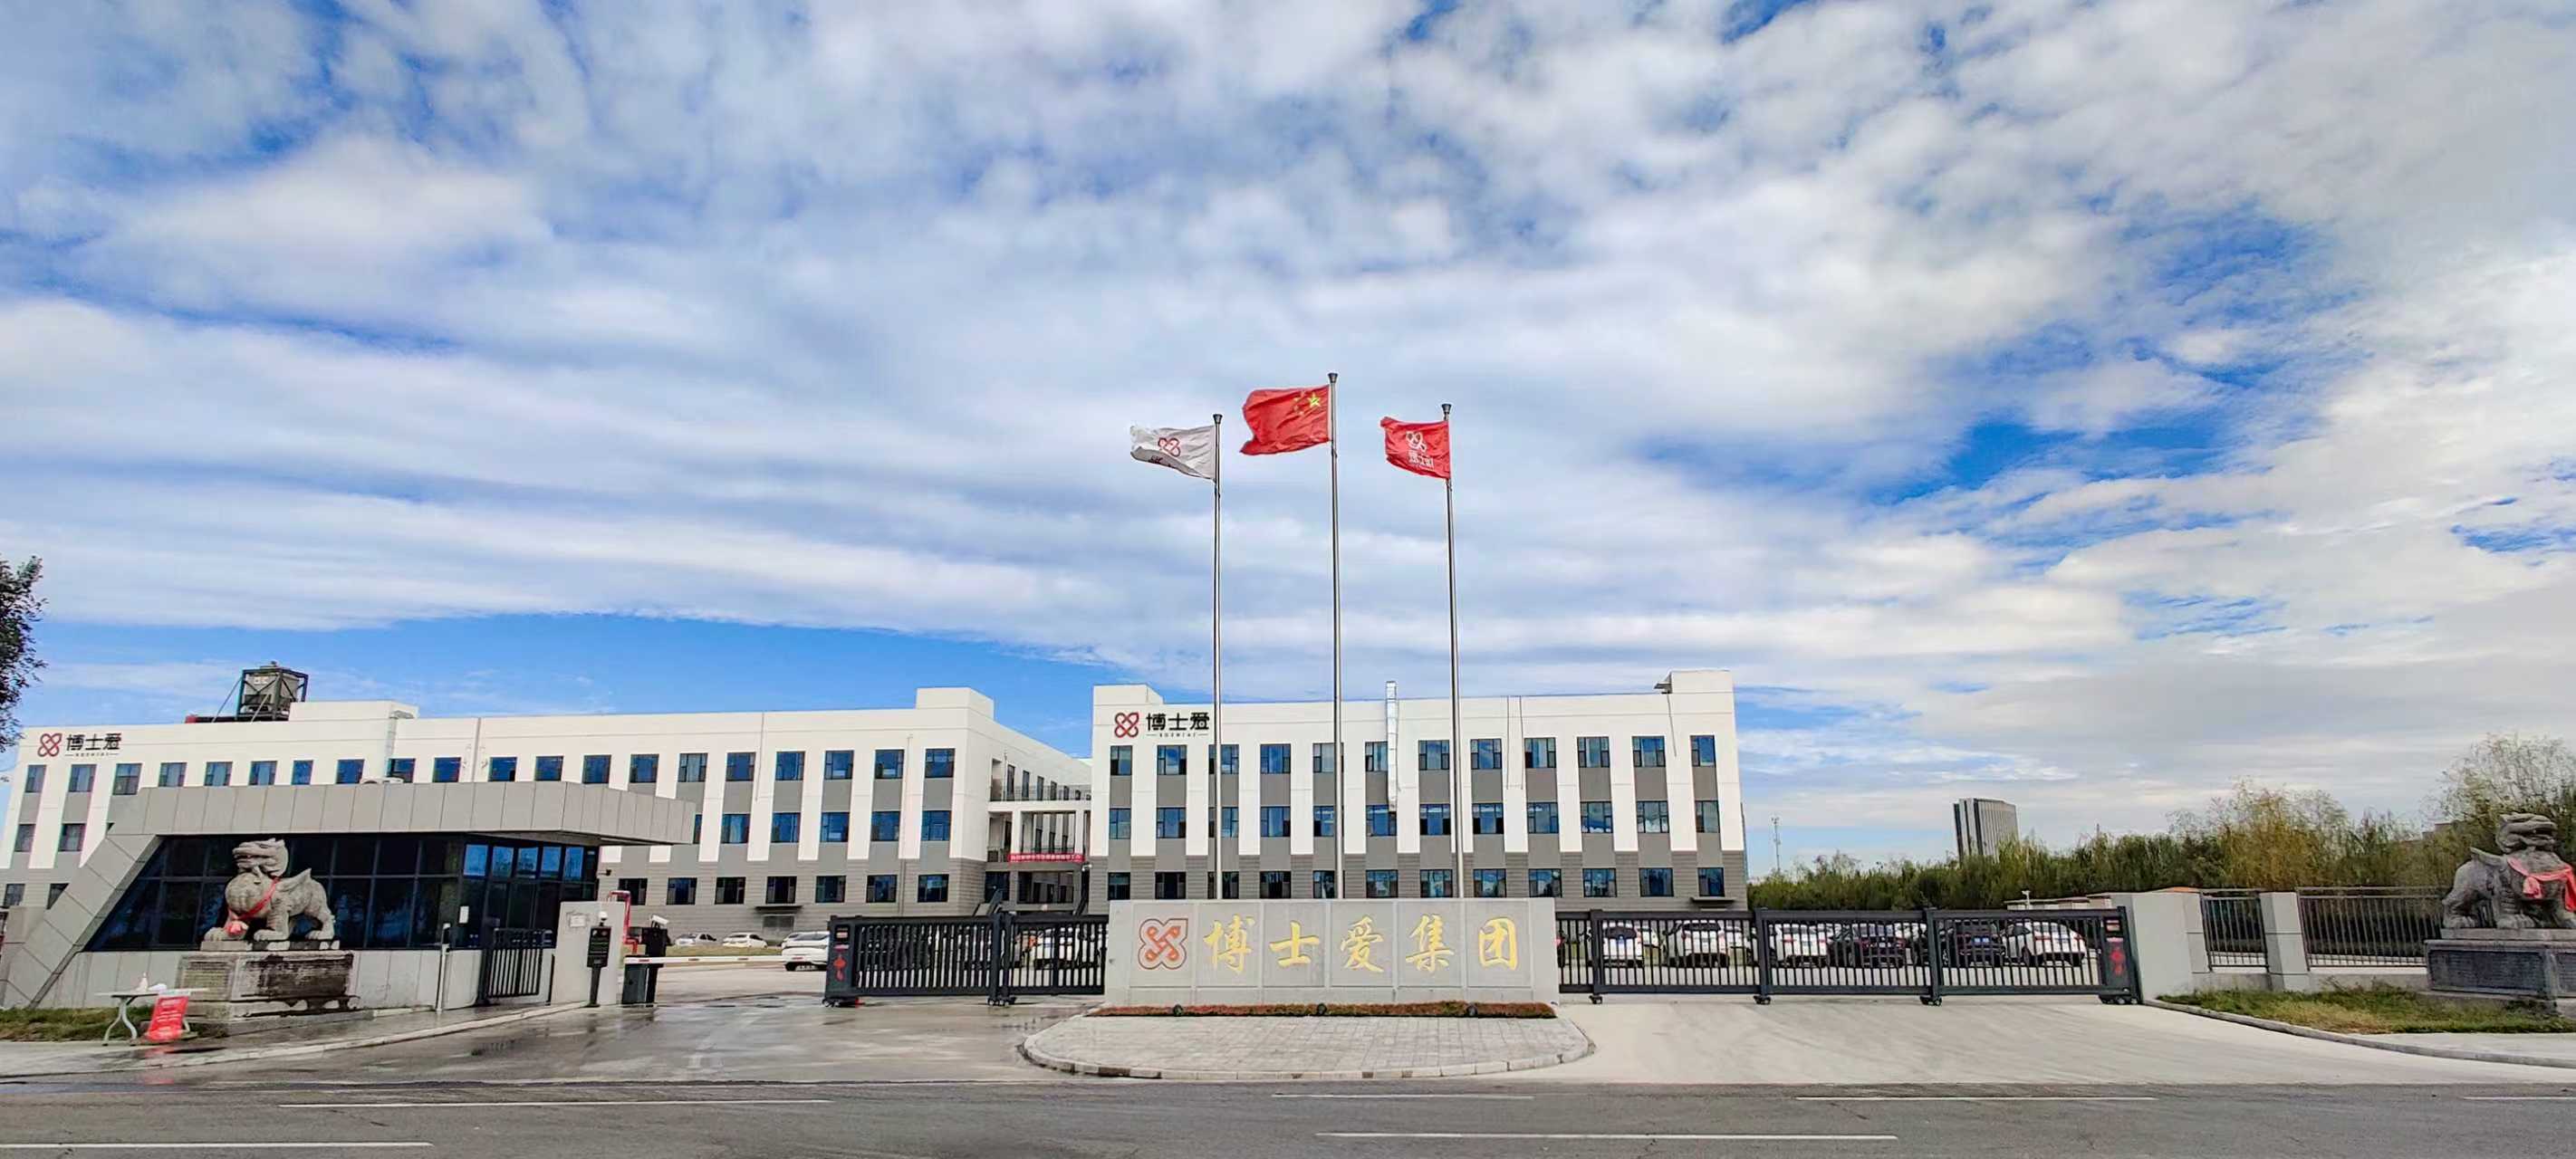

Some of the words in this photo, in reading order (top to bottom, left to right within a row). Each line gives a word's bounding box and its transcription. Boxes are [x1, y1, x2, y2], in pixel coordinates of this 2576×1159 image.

[1146, 712, 1210, 731] 博士爱
[66, 733, 122, 751] 博士爱
[1203, 914, 1519, 973] 博士爱集团
